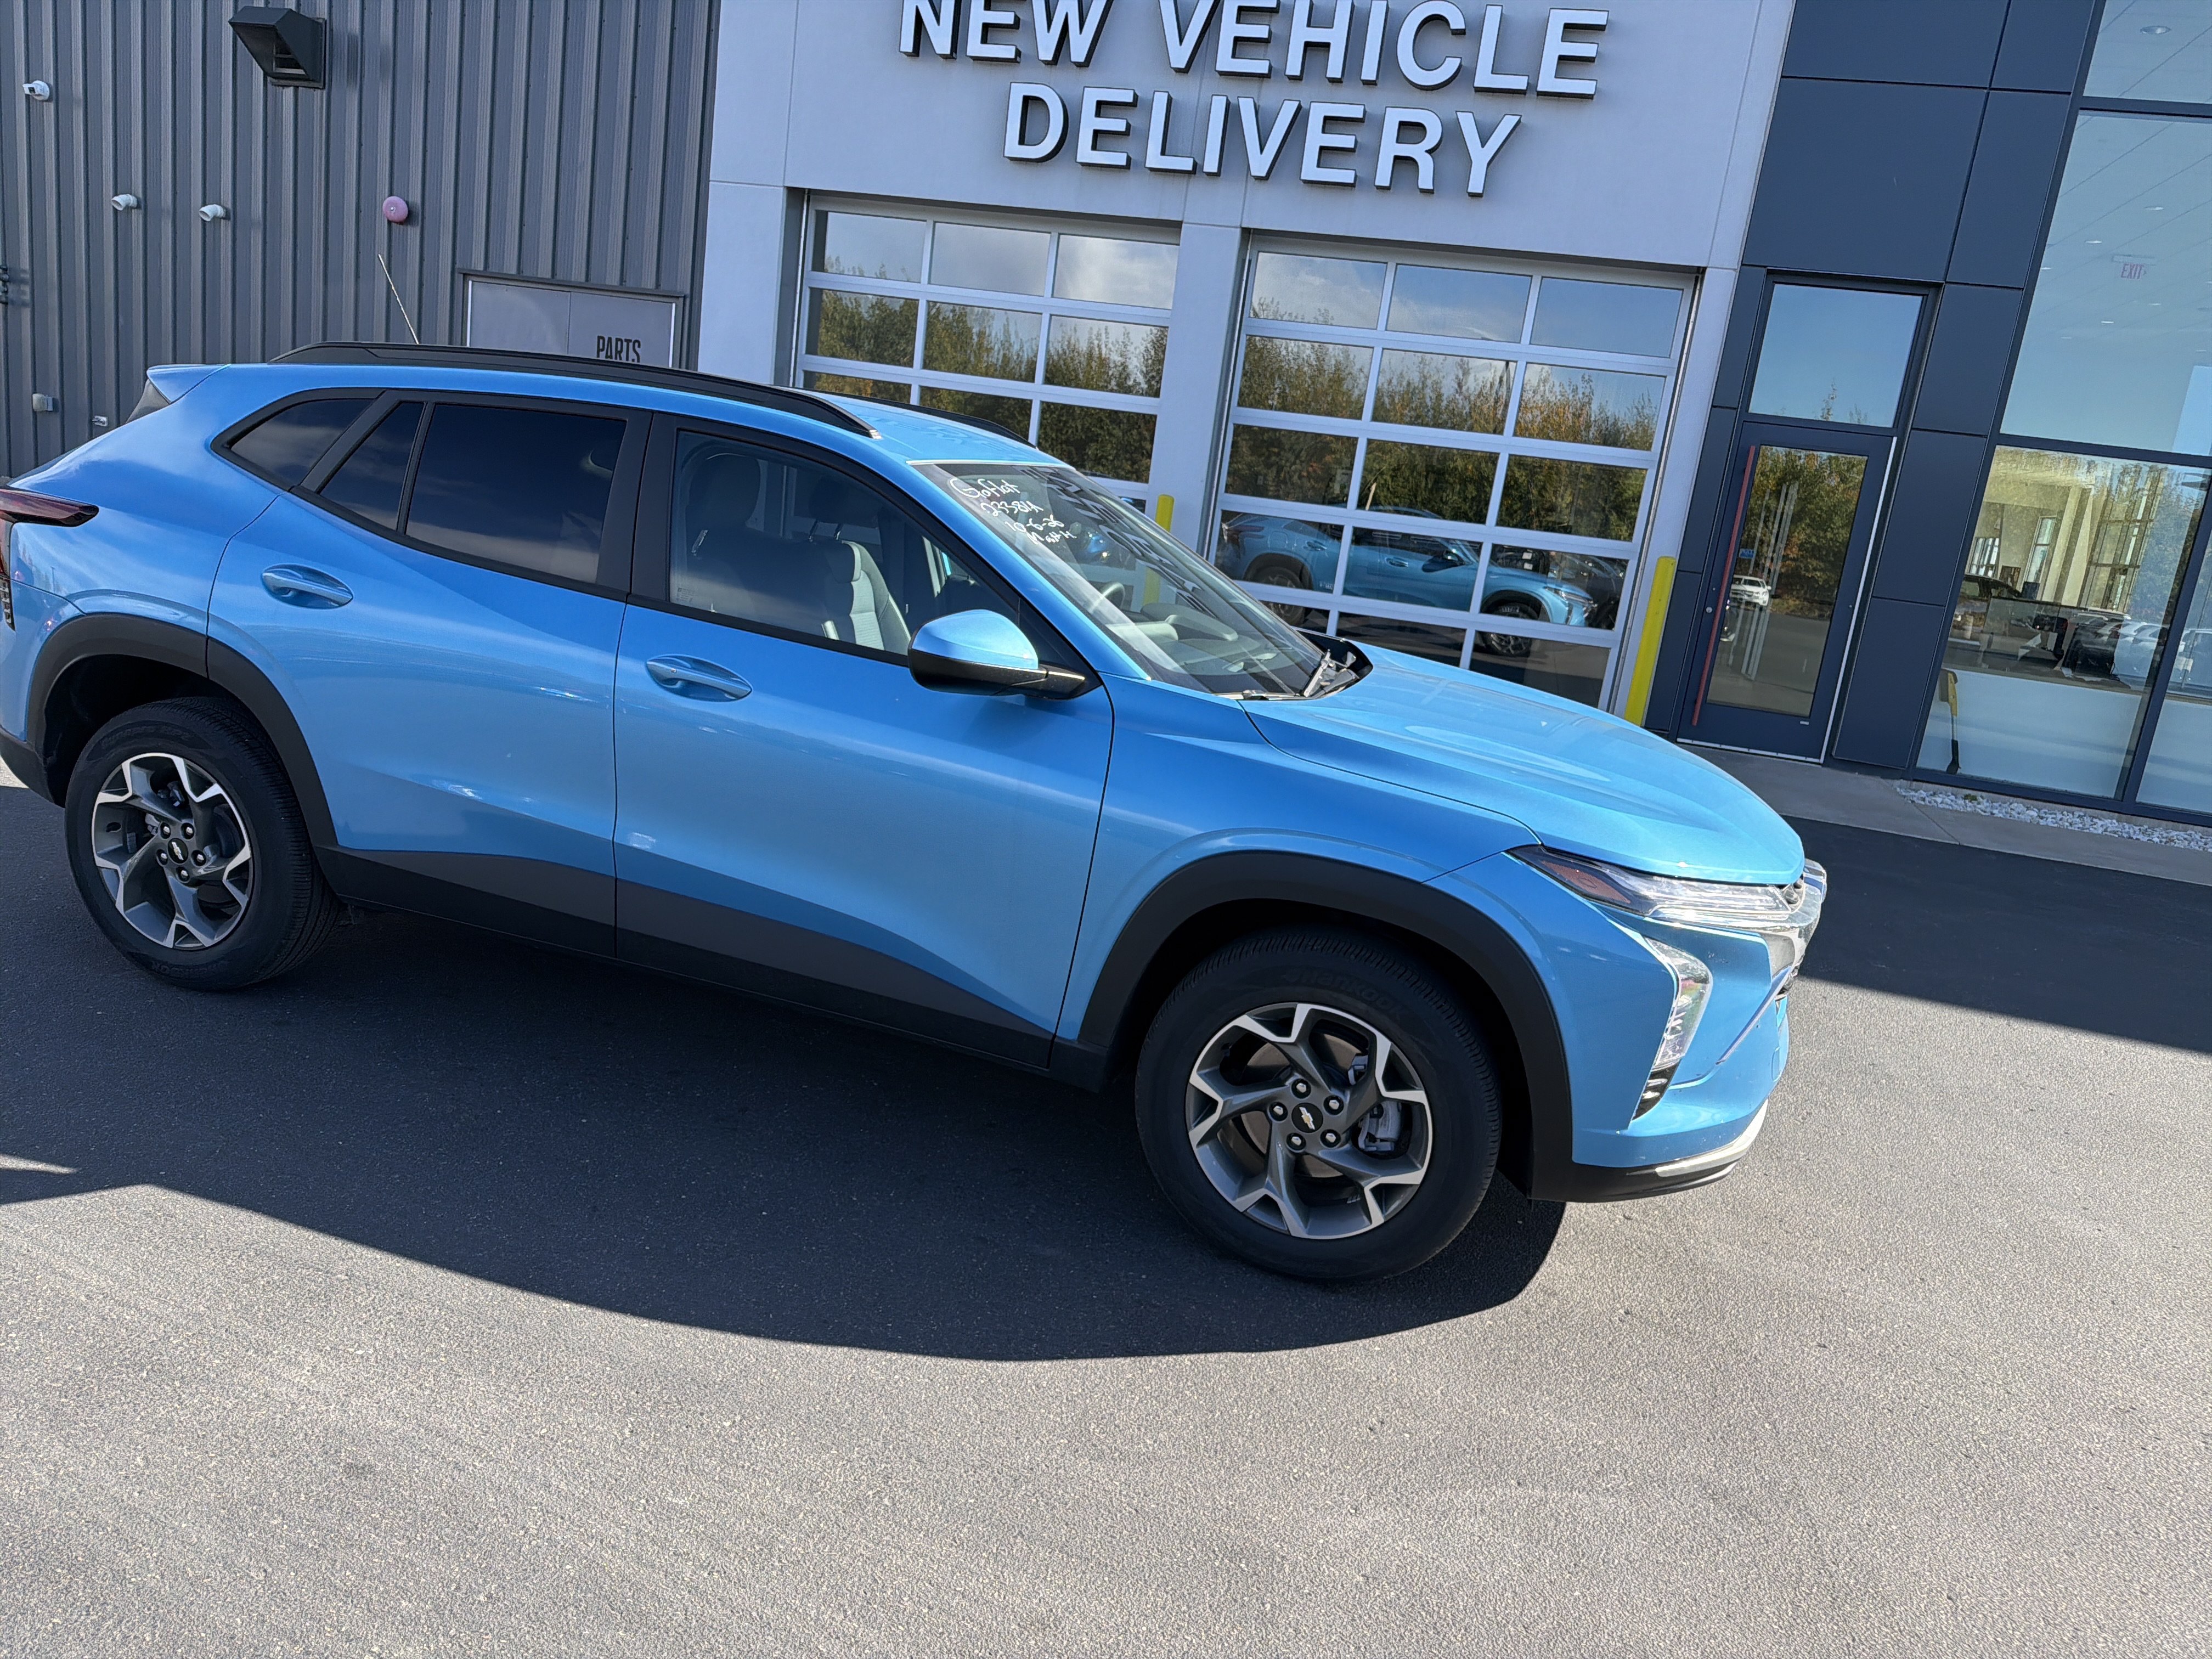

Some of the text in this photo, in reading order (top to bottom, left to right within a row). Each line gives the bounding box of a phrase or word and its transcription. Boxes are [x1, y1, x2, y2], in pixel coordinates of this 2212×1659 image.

[899, 0, 1609, 99] NEW VEHICLE
[1003, 82, 1522, 196] DELIVERY
[2120, 263, 2145, 279] EXIT
[596, 335, 641, 363] PARTS
